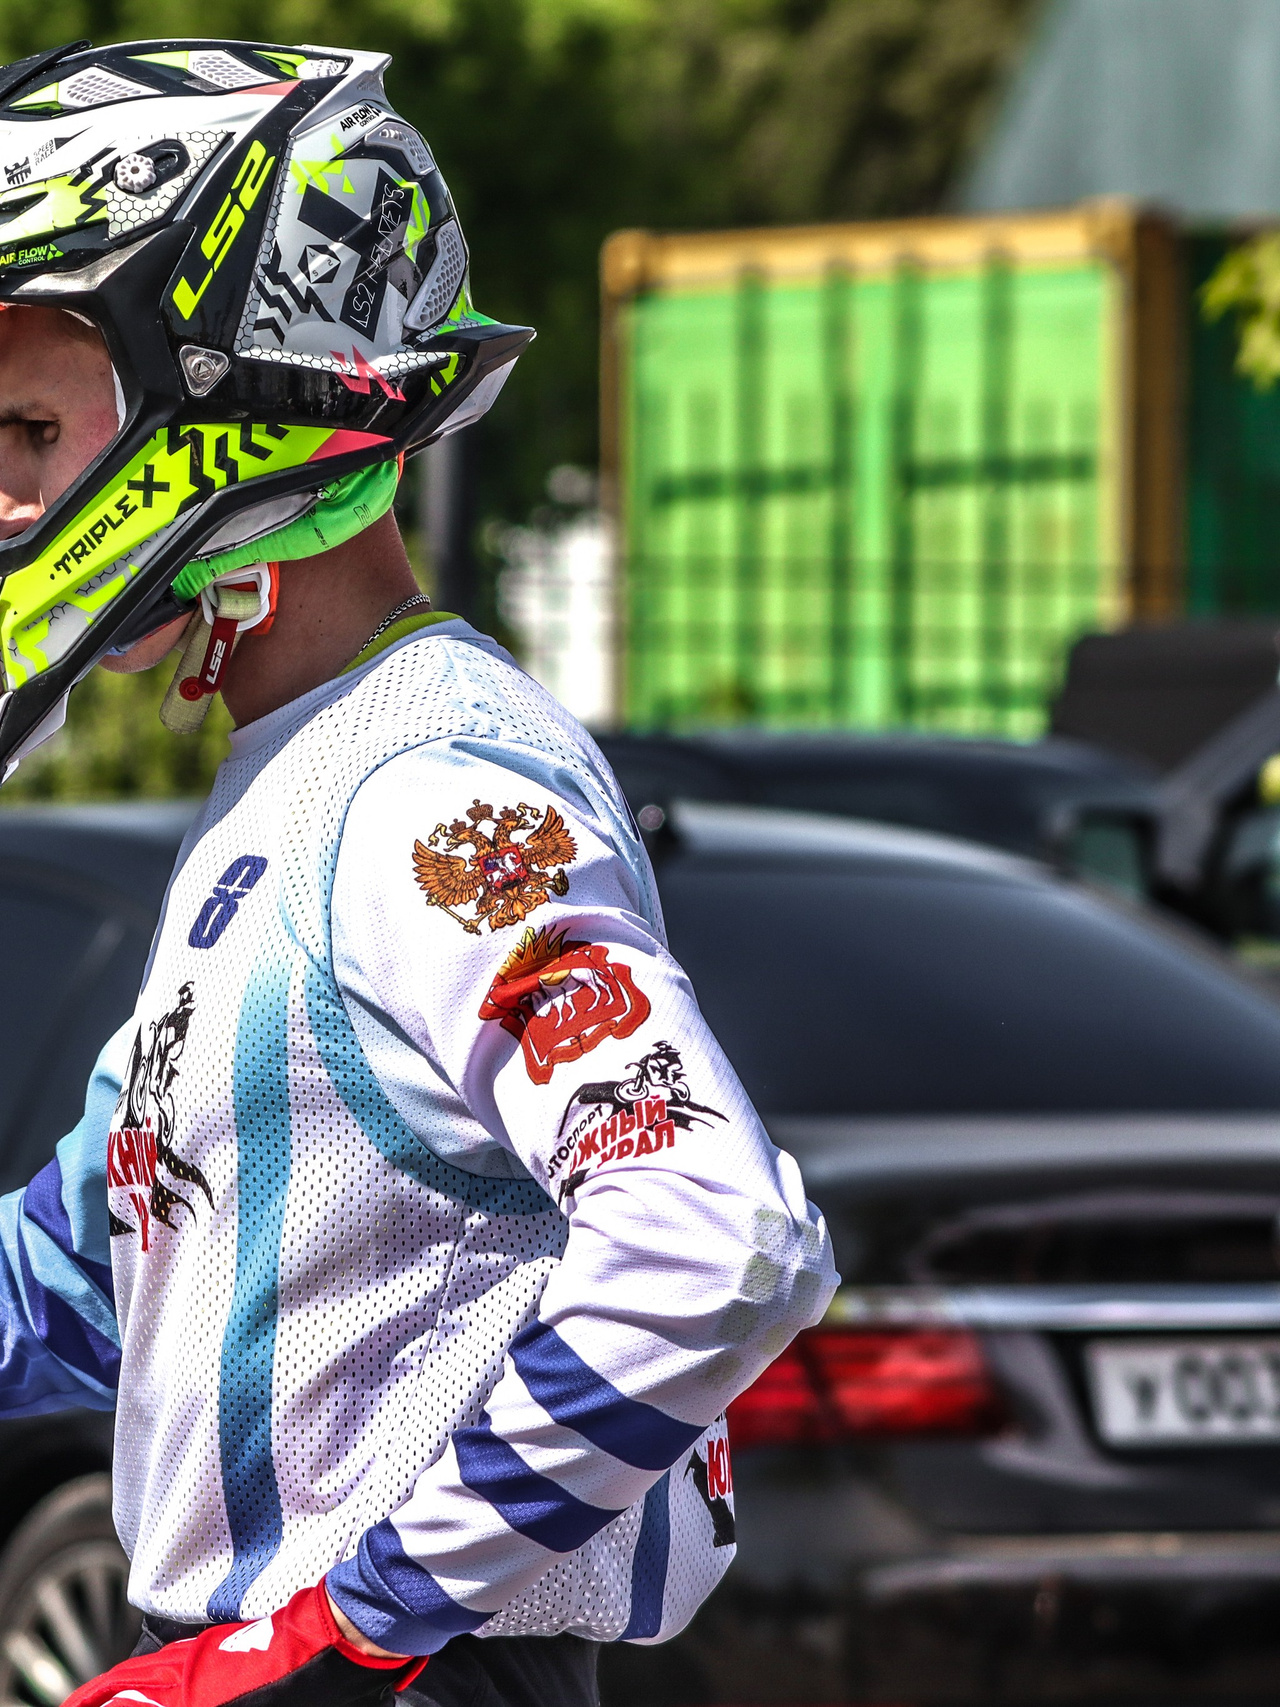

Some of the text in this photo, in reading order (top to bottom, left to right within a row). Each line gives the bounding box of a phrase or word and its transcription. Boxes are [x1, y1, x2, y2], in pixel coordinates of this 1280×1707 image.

[340, 104, 372, 132] AIR FLOW
[172, 139, 276, 321] LS2
[18, 256, 46, 266] CONTROL
[19, 245, 48, 260] FLOW
[206, 638, 227, 685] LS2
